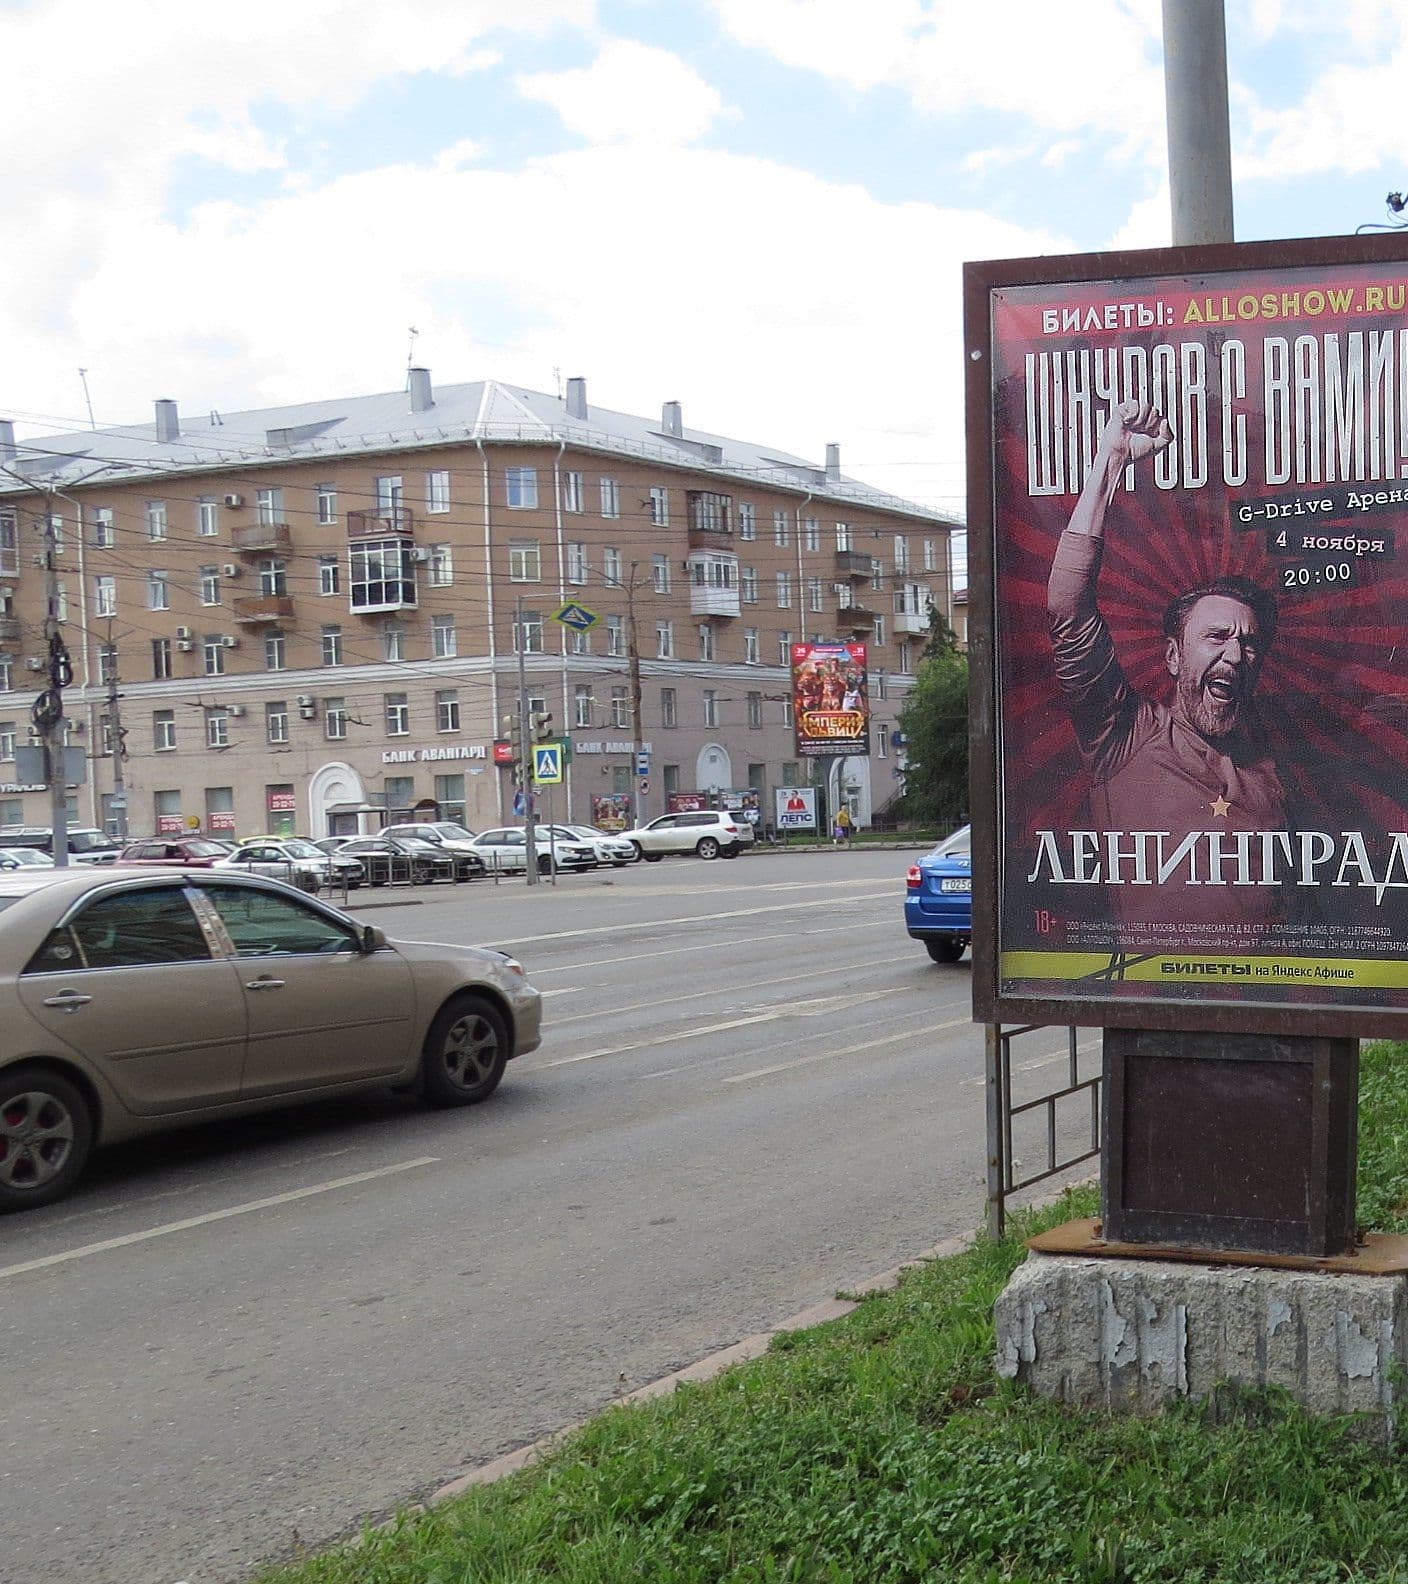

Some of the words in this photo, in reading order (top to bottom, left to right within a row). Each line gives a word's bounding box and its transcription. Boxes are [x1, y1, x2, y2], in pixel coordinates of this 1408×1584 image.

[1042, 301, 1174, 334] БИЛЕТЫ:
[1183, 285, 1407, 324] ALLOSHOW.RU
[1025, 342, 1208, 497] ШНУРОВ
[1220, 339, 1247, 487] С
[1238, 497, 1334, 523] G-Drive
[1275, 531, 1287, 548] 4
[1302, 534, 1385, 555] ноября
[1283, 563, 1352, 587] 20:00
[382, 750, 417, 763] БАНК
[421, 746, 488, 761] АВАНГАРД
[780, 814, 813, 823] ЛЕПС
[1034, 909, 1057, 934] 18+
[1161, 962, 1251, 975] БИЛЕТЫ
[1255, 966, 1269, 976] на
[1272, 965, 1312, 978] Яндекс
[1314, 966, 1354, 980] Афише
